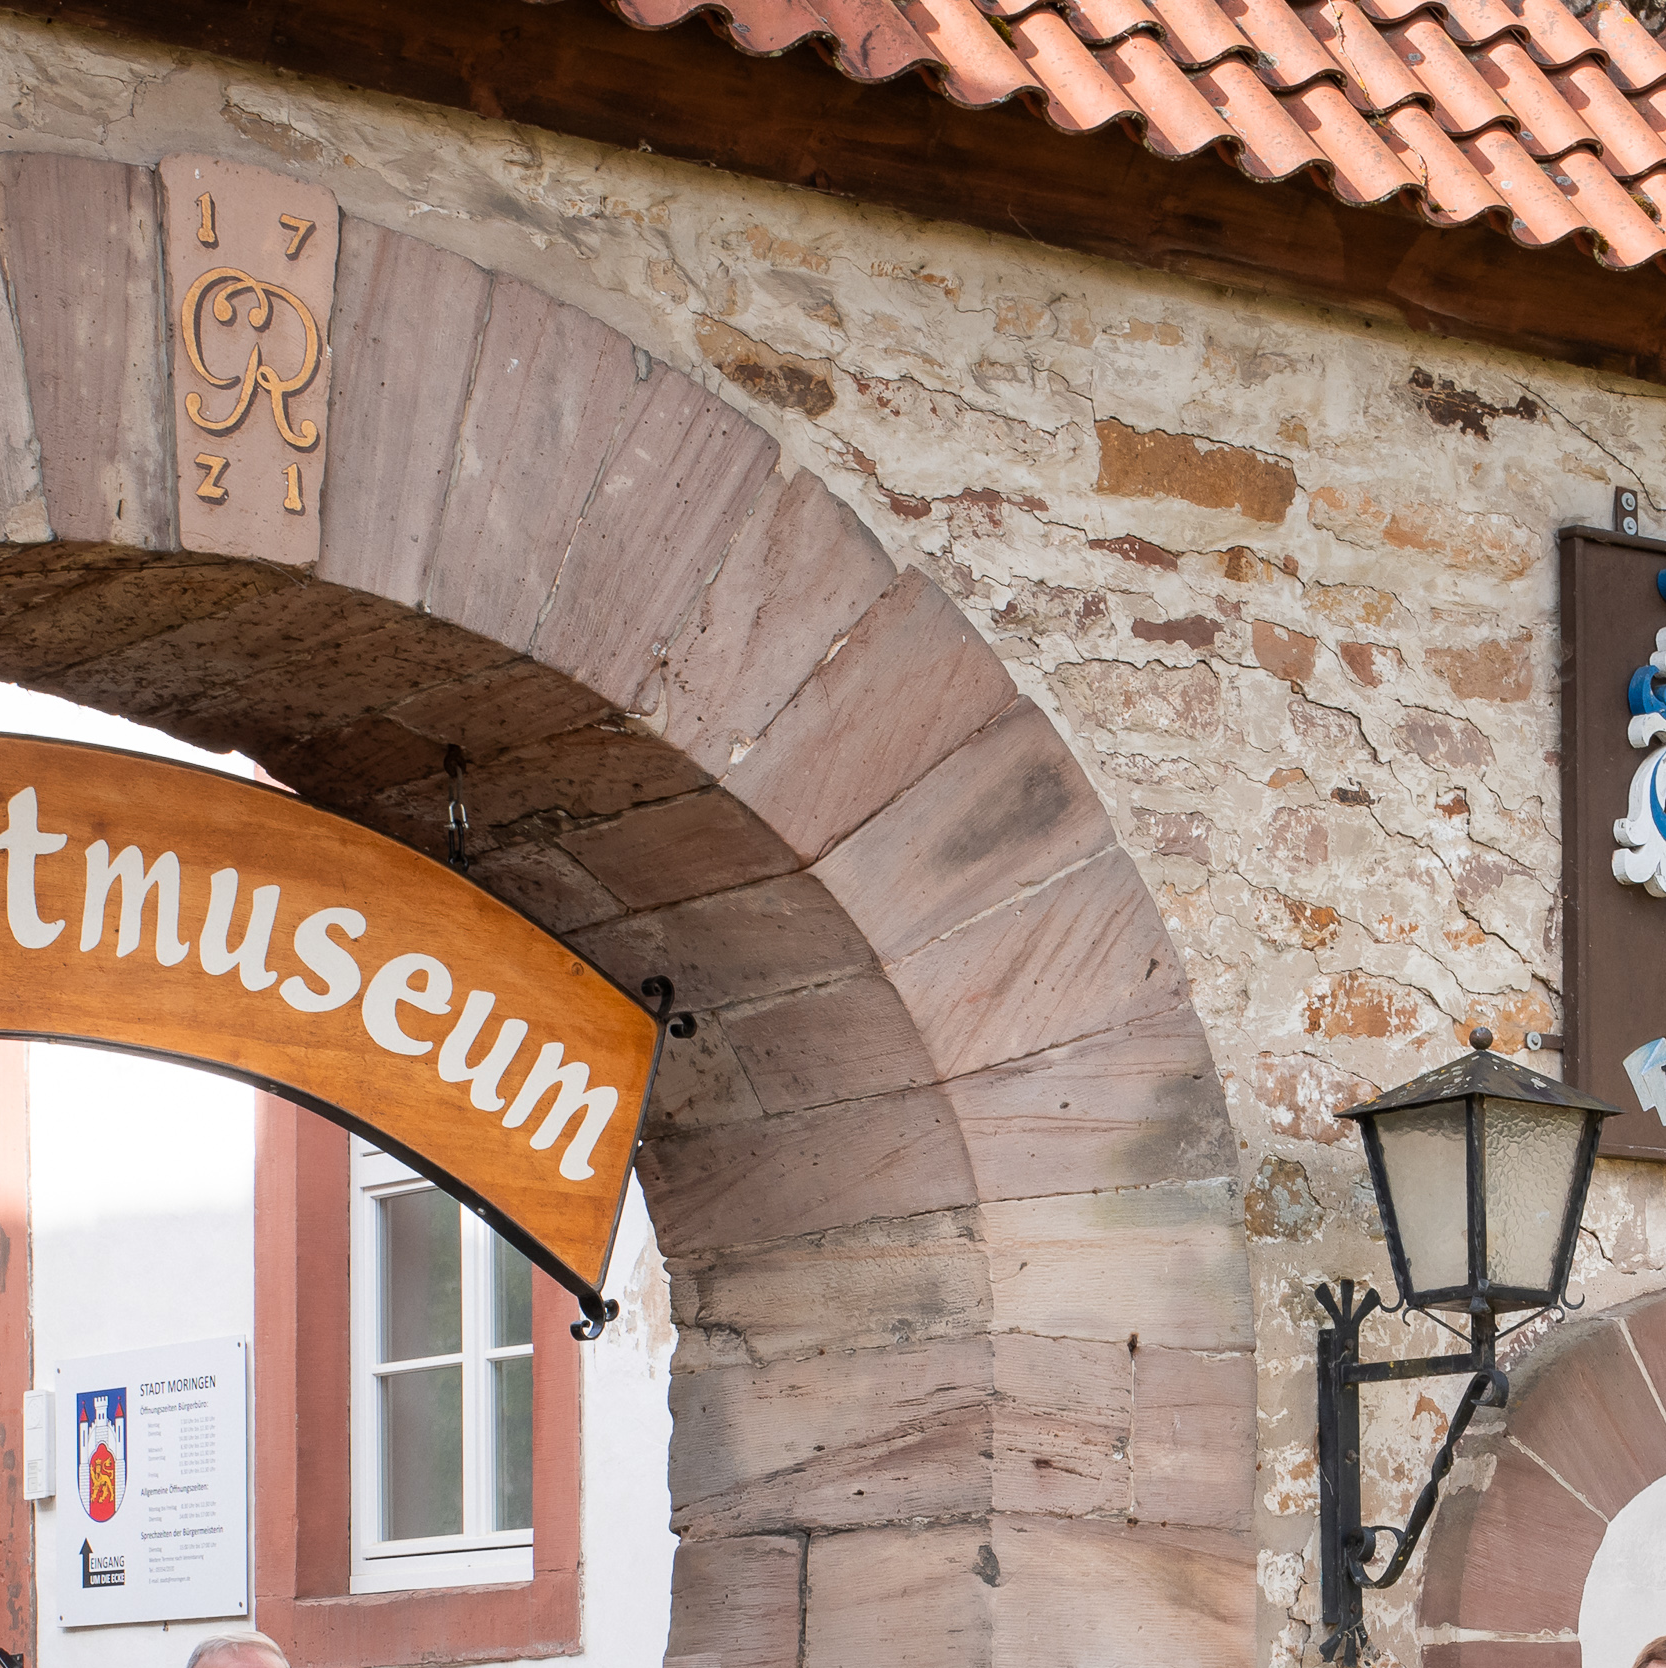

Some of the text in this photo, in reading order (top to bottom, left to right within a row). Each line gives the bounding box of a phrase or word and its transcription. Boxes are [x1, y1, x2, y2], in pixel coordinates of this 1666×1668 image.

[140, 1375, 216, 1397] STADT MORINGEN
[90, 1555, 125, 1570] EINGANG
[90, 1572, 125, 1585] UM DIE ECKE
